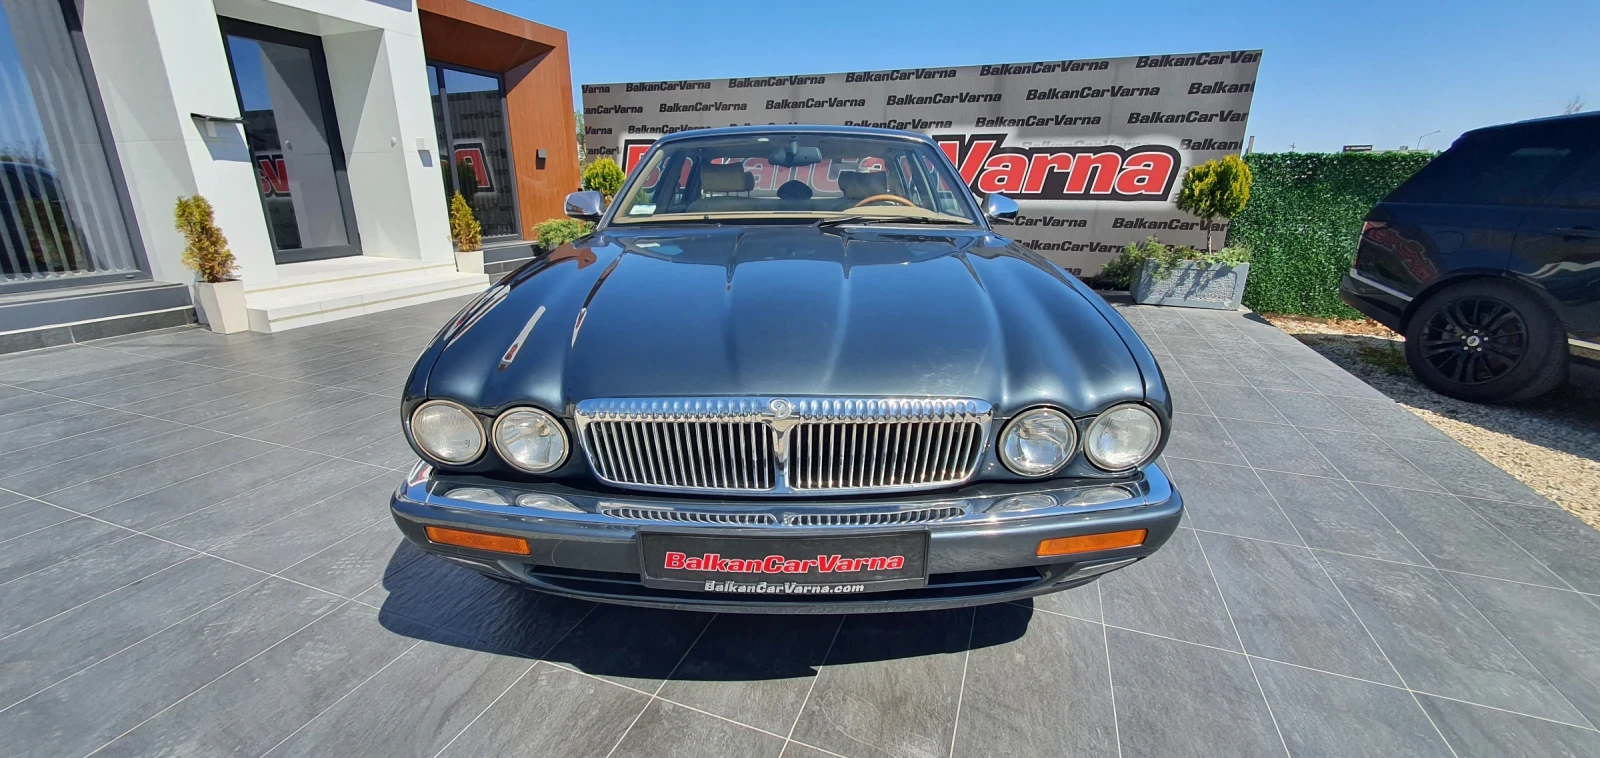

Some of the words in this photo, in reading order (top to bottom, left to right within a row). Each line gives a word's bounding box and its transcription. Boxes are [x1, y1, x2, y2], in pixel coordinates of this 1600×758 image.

[979, 60, 1109, 76] BalkanCarVarna
[728, 75, 826, 89] BalkanCarVarna
[845, 69, 957, 83] BalkanCarVarna
[625, 81, 711, 93] BalkanCarVarna
[1026, 86, 1160, 101] BalkanCarVarna
[765, 97, 866, 110] BalkanCarVarna
[886, 92, 1003, 106] BalkanCarVarna
[584, 105, 643, 115] anCarVarna
[659, 102, 747, 113] BalkanCarVarna
[975, 115, 1102, 128] BalkanCarVarna
[585, 126, 613, 135] Varna
[664, 551, 905, 574] BalkanCarVarna
[704, 580, 865, 594] BalkanCarVarna.com
